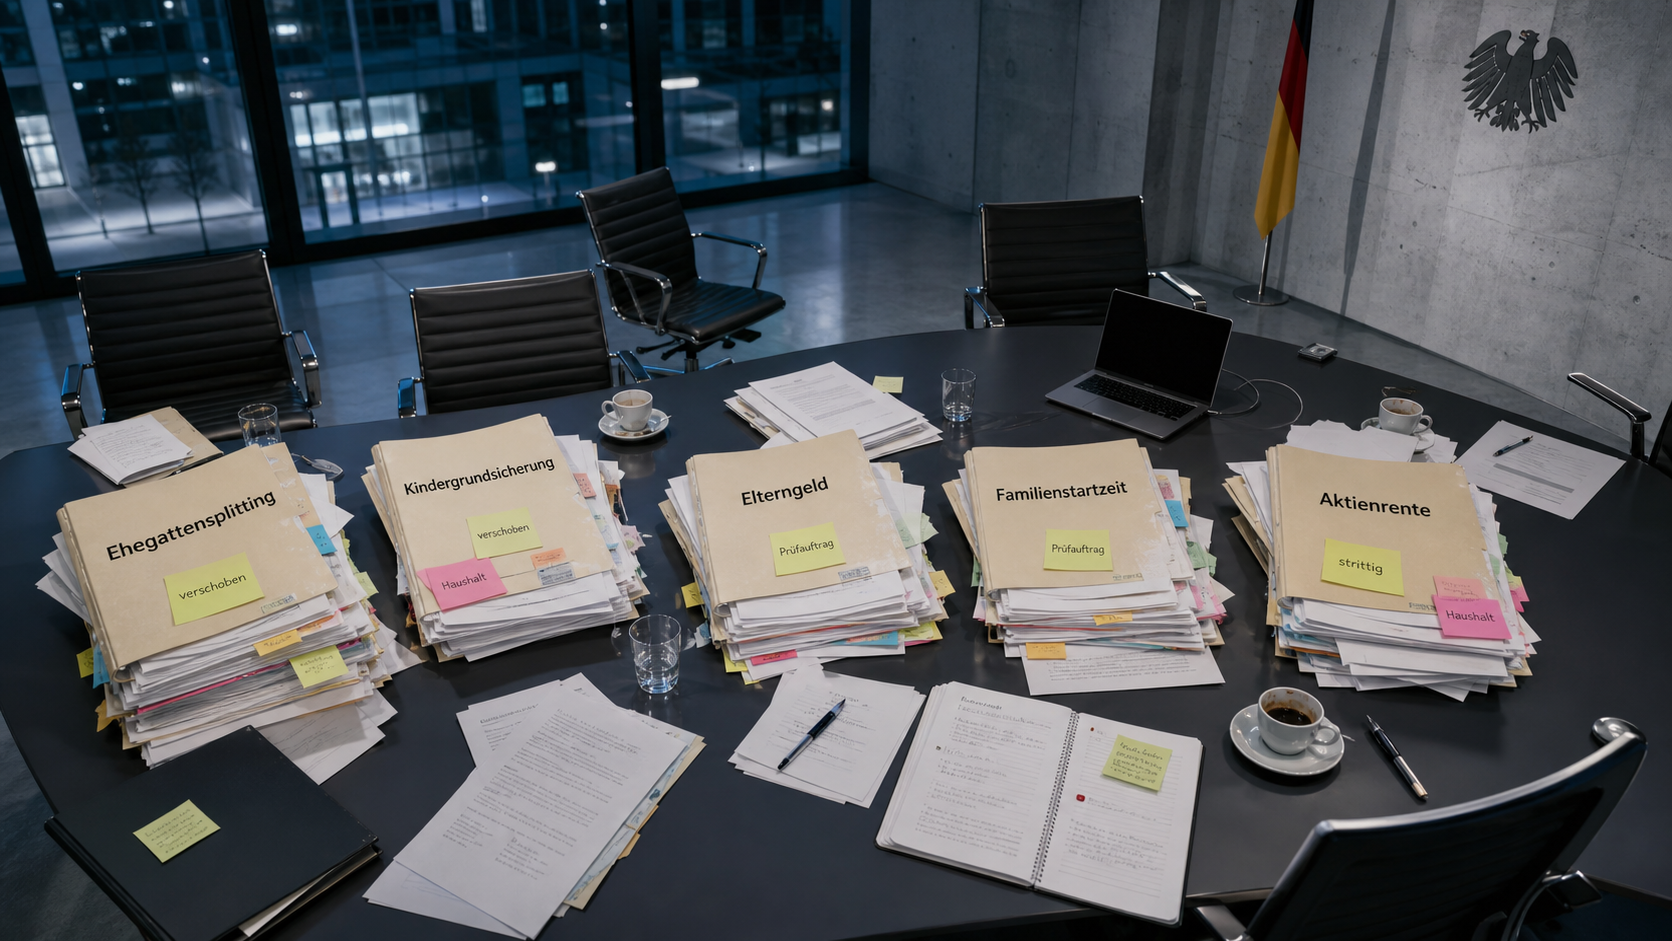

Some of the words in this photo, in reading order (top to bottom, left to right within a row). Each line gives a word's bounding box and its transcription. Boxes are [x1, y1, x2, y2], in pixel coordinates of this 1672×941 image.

[404, 458, 555, 495] Kindergrundsicherung
[741, 476, 829, 506] Elterngeld
[996, 481, 1128, 502] Familienstartzeit
[1320, 492, 1431, 517] Aktienrente
[106, 491, 276, 561] Ehegattensplitting
[477, 523, 530, 540] verschoben
[779, 539, 835, 557] Prüfauftrag
[1051, 543, 1105, 557] Prüfauftrag
[1338, 557, 1383, 576] strittig
[178, 573, 247, 601] verschoben
[441, 573, 487, 591] Haushalt
[1446, 609, 1496, 623] Haushalt
